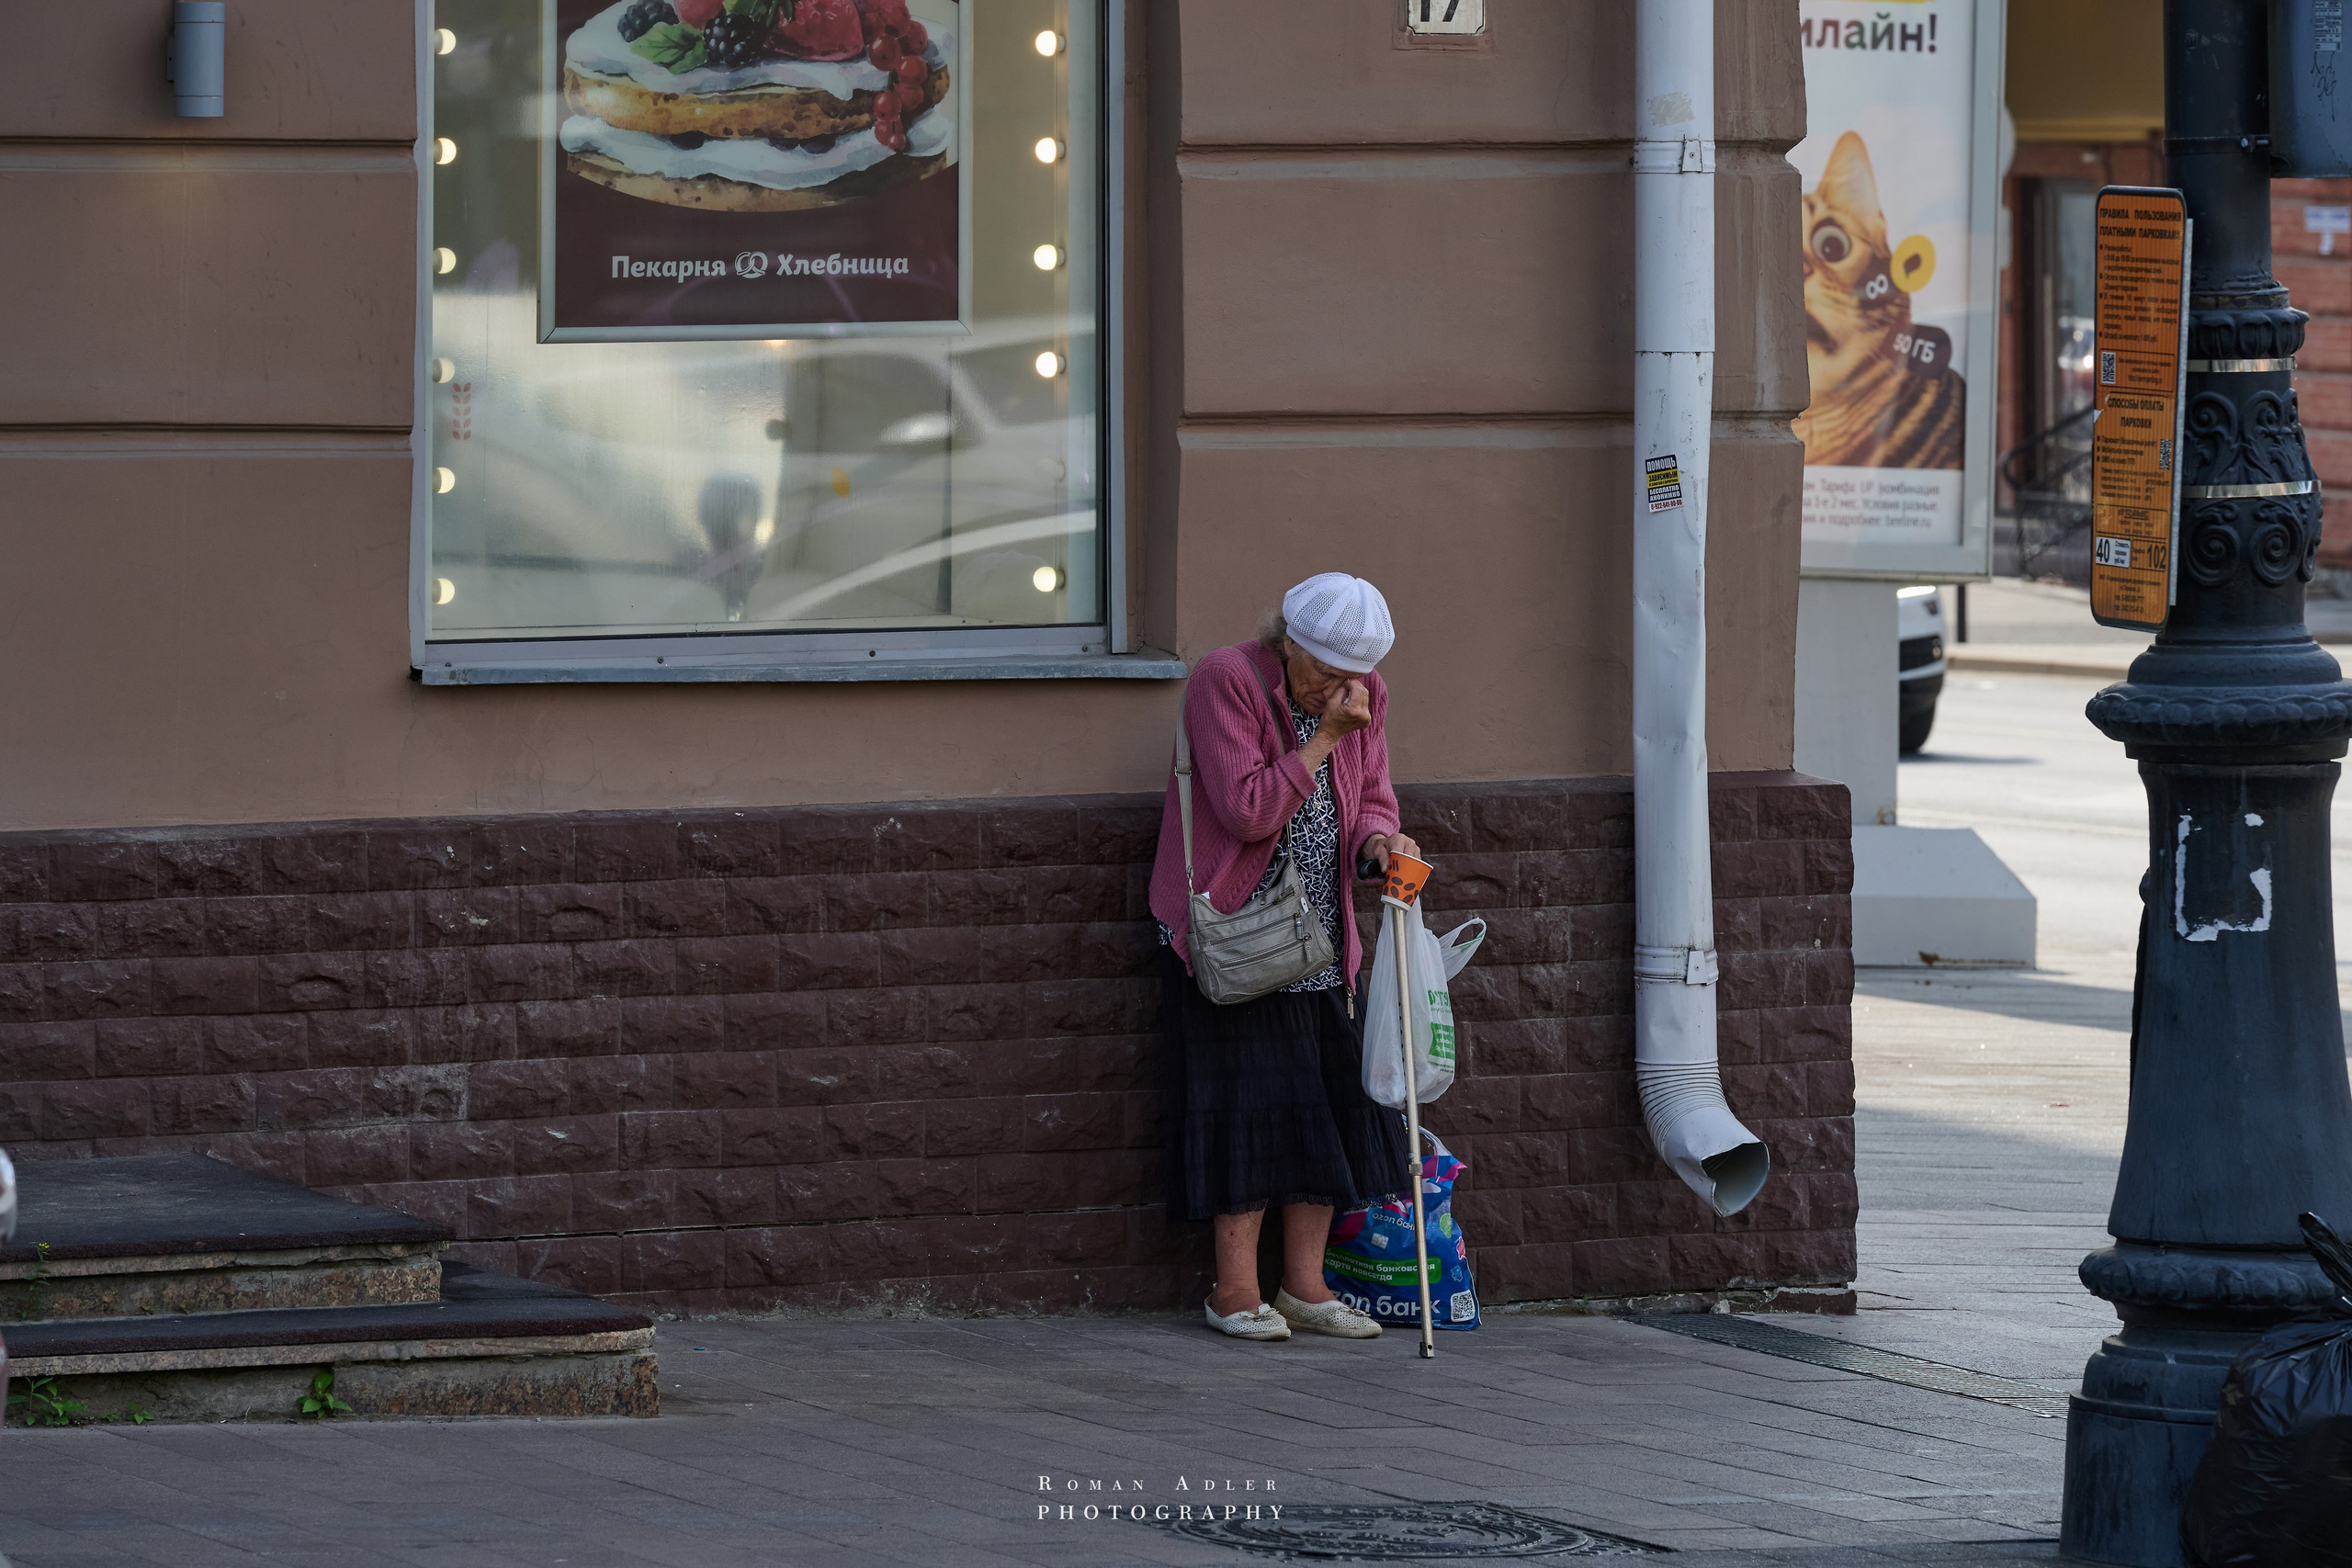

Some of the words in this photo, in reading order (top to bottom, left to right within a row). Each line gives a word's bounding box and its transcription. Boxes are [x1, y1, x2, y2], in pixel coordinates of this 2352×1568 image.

[2099, 208, 2130, 220] ПРАВИЛА
[2134, 209, 2182, 221] ПОЛЬЗОВАНИЯ
[2099, 226, 2136, 237] ПЛАТНЫМИ
[612, 255, 726, 283] Пекарня
[776, 253, 909, 278] Хлебница
[1912, 337, 1937, 365] ГБ
[2108, 398, 2139, 409] СПОСОБЫ
[2141, 400, 2165, 412] ОПЛАТЫ
[2120, 416, 2153, 429] ПАРКОВКИ
[1646, 457, 1676, 472] ПОМОЩЬ
[1648, 470, 1678, 482] ЗАВИСИМЫМ
[1649, 484, 1679, 495] БЕСПЛАТНО
[1650, 491, 1680, 502] АНОНИМНО
[2097, 538, 2110, 563] 40
[2147, 544, 2166, 570] 102
[1373, 1213, 1395, 1224] ozon
[1396, 1217, 1416, 1231] бан
[1326, 1247, 1374, 1270] Бесплатная
[1375, 1263, 1435, 1272] банковся
[1324, 1258, 1351, 1269] карта
[1353, 1267, 1393, 1281] навсегда
